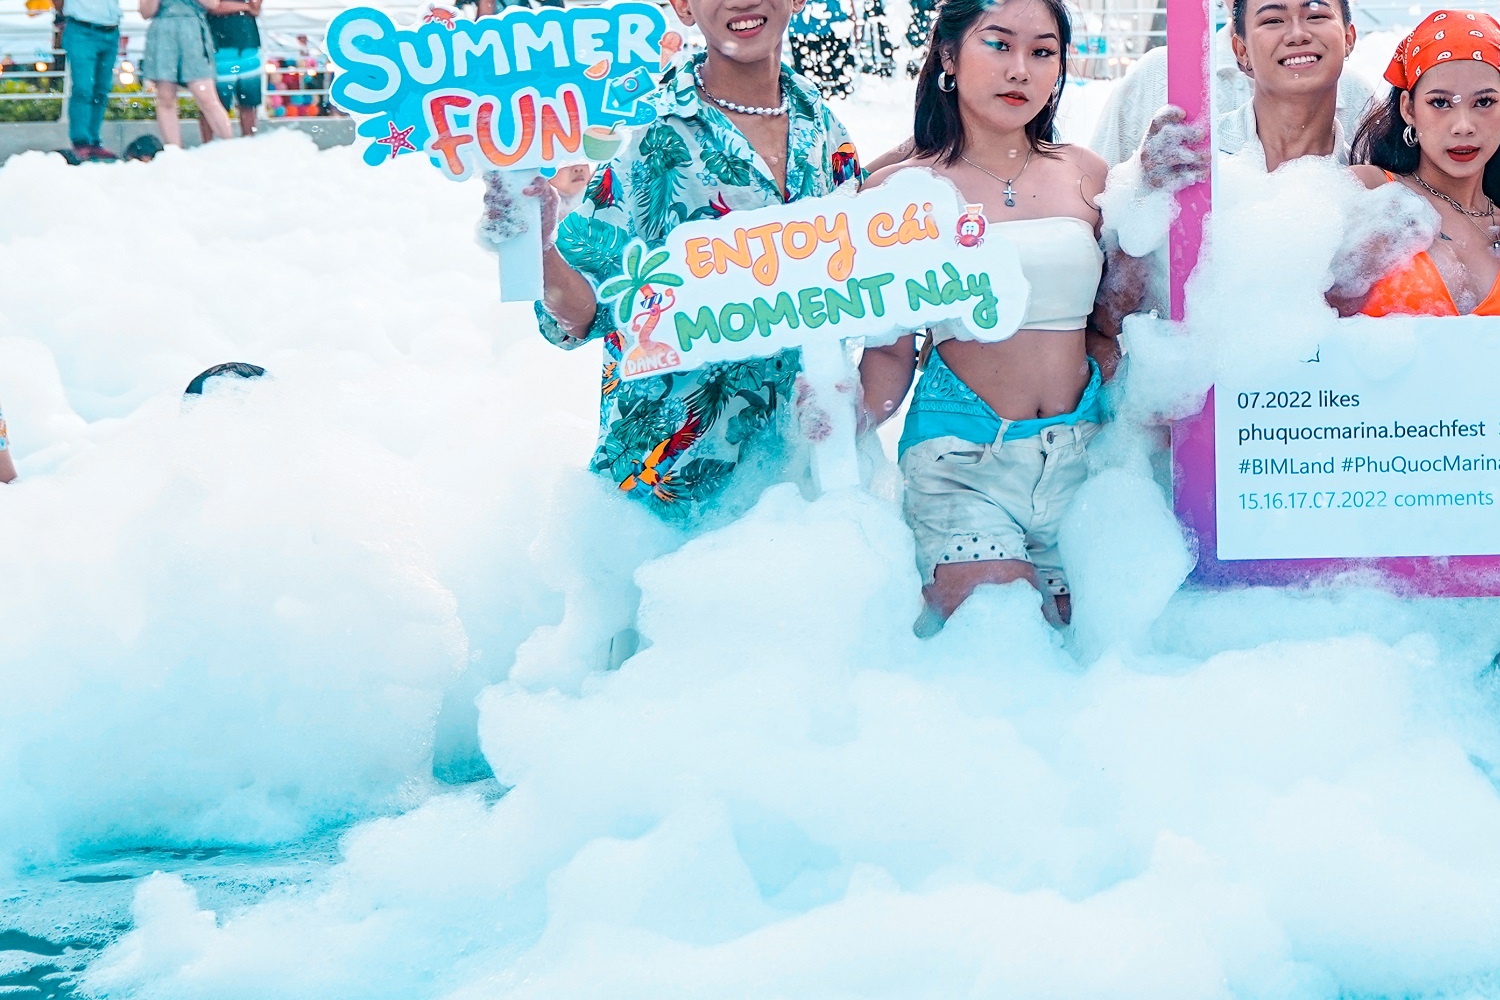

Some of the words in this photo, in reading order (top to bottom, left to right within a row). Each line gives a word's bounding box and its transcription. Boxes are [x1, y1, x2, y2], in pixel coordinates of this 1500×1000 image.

[338, 12, 662, 104] SUMMER
[429, 90, 583, 176] FUN
[685, 211, 856, 287] ENJOY
[673, 272, 895, 353] MOMENT
[626, 350, 679, 375] DANCE
[1237, 390, 1313, 410] 07.2022
[1318, 389, 1361, 408] likes
[1238, 418, 1487, 447] phuquocmarina.beachfest
[1238, 456, 1335, 476] #BIMLand
[1238, 490, 1388, 511] 15.16.17.07.2022
[1394, 489, 1494, 508] comments
